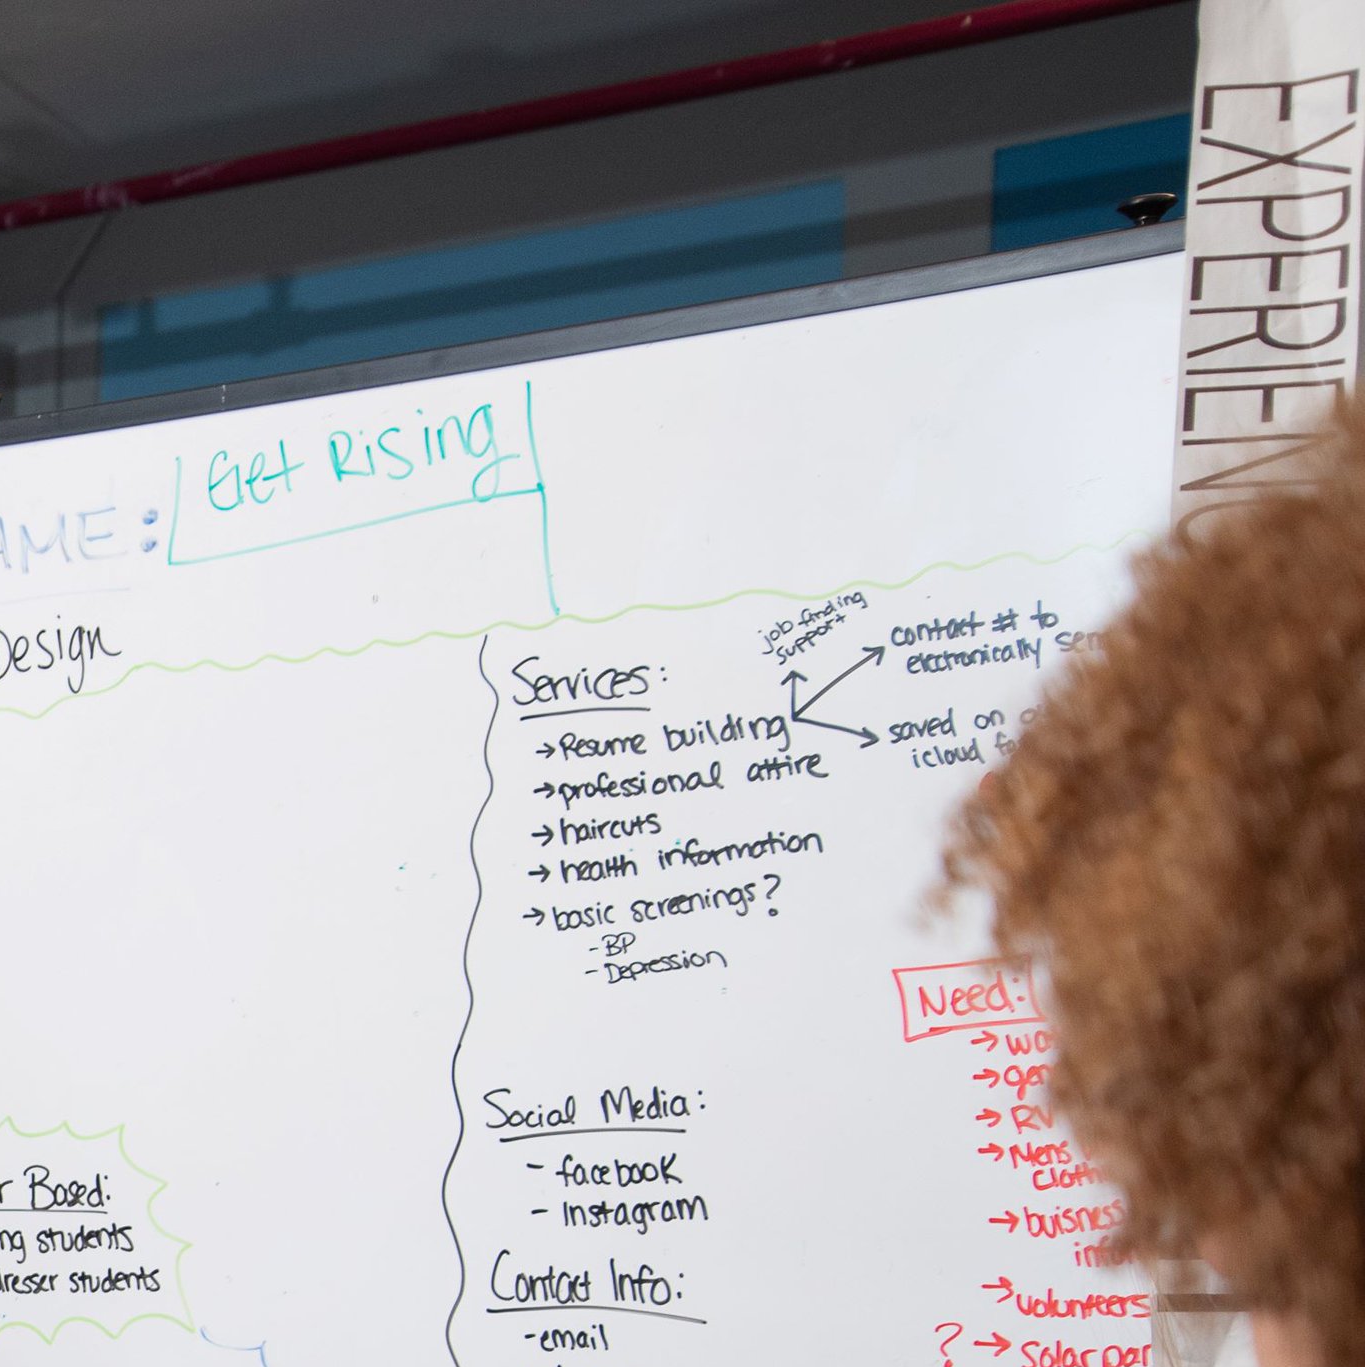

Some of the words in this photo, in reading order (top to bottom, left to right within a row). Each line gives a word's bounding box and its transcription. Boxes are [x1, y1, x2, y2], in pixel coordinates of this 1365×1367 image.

[207, 440, 305, 511] Get
[328, 403, 521, 502] Rising
[758, 620, 794, 655] job
[797, 591, 868, 627] finding
[776, 614, 846, 666] support
[890, 610, 986, 648] contact
[991, 607, 1019, 634] #
[1030, 599, 1059, 630] to
[511, 656, 668, 706] Services:
[559, 727, 648, 761] Resume
[663, 712, 793, 752] building
[888, 707, 958, 744] saved
[973, 708, 1006, 731] on
[911, 737, 986, 769] icloud
[557, 757, 723, 810] professional
[746, 750, 830, 784] attire
[559, 811, 663, 845] haircuts
[560, 845, 639, 885] health
[656, 828, 825, 871] information
[552, 891, 617, 931] basic
[601, 931, 638, 957] BP
[605, 947, 729, 984] Depression
[919, 969, 1028, 1018] Need:
[482, 1087, 577, 1129] Social
[600, 1085, 707, 1123] Media:
[23, 1165, 111, 1211] Based:
[555, 1152, 684, 1188] facebook
[562, 1194, 710, 1236] Instagram
[36, 1222, 135, 1254] students
[68, 1264, 161, 1293] students
[490, 1248, 592, 1304] Contact
[609, 1257, 686, 1307] Info:
[1017, 1288, 1151, 1319] volunteers
